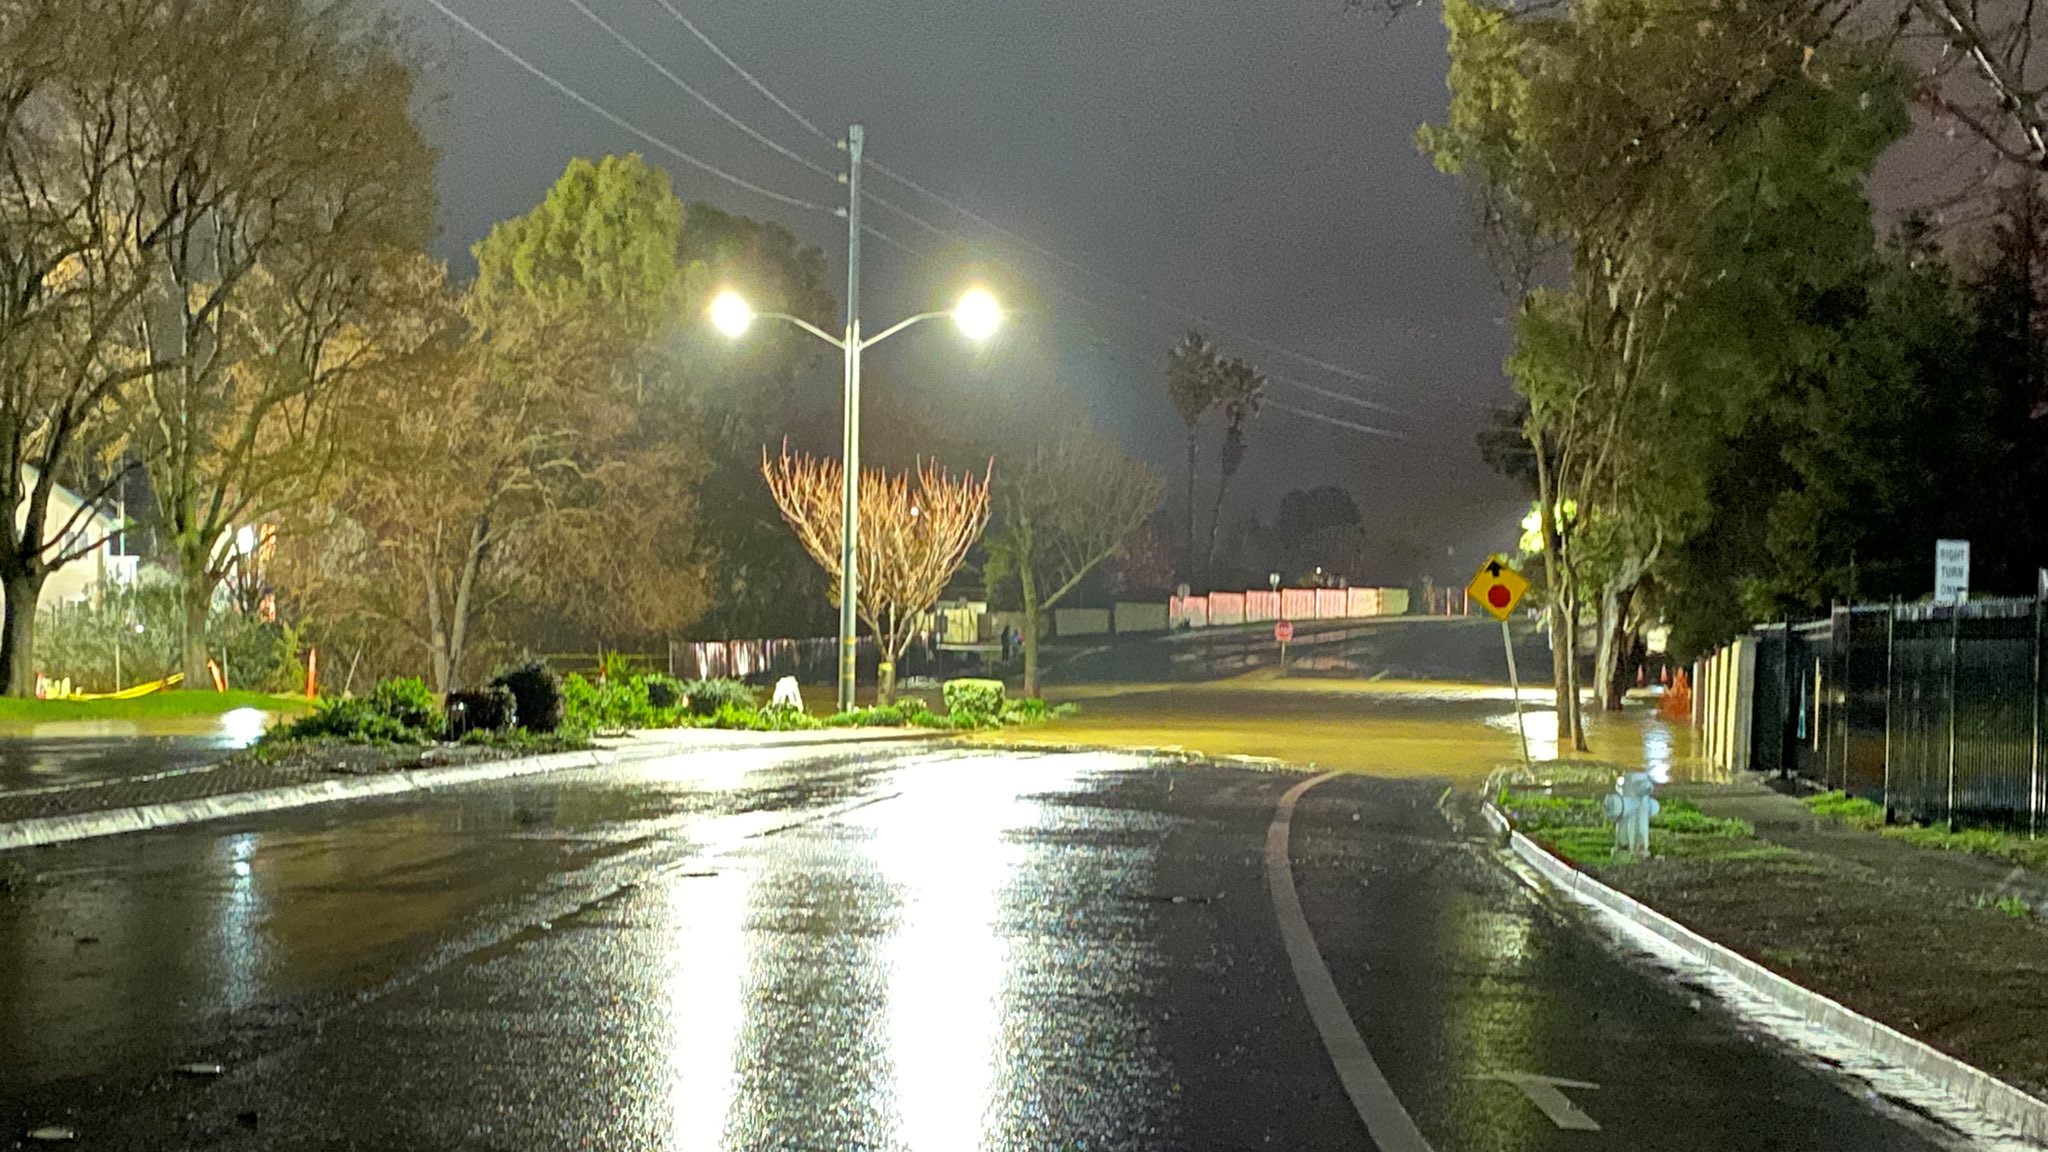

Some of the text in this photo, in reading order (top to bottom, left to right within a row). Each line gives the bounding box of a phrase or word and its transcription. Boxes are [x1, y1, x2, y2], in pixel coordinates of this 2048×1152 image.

[1940, 549, 1965, 561] RIGHT
[1941, 566, 1964, 578] TURN
[1940, 584, 1964, 596] ON
